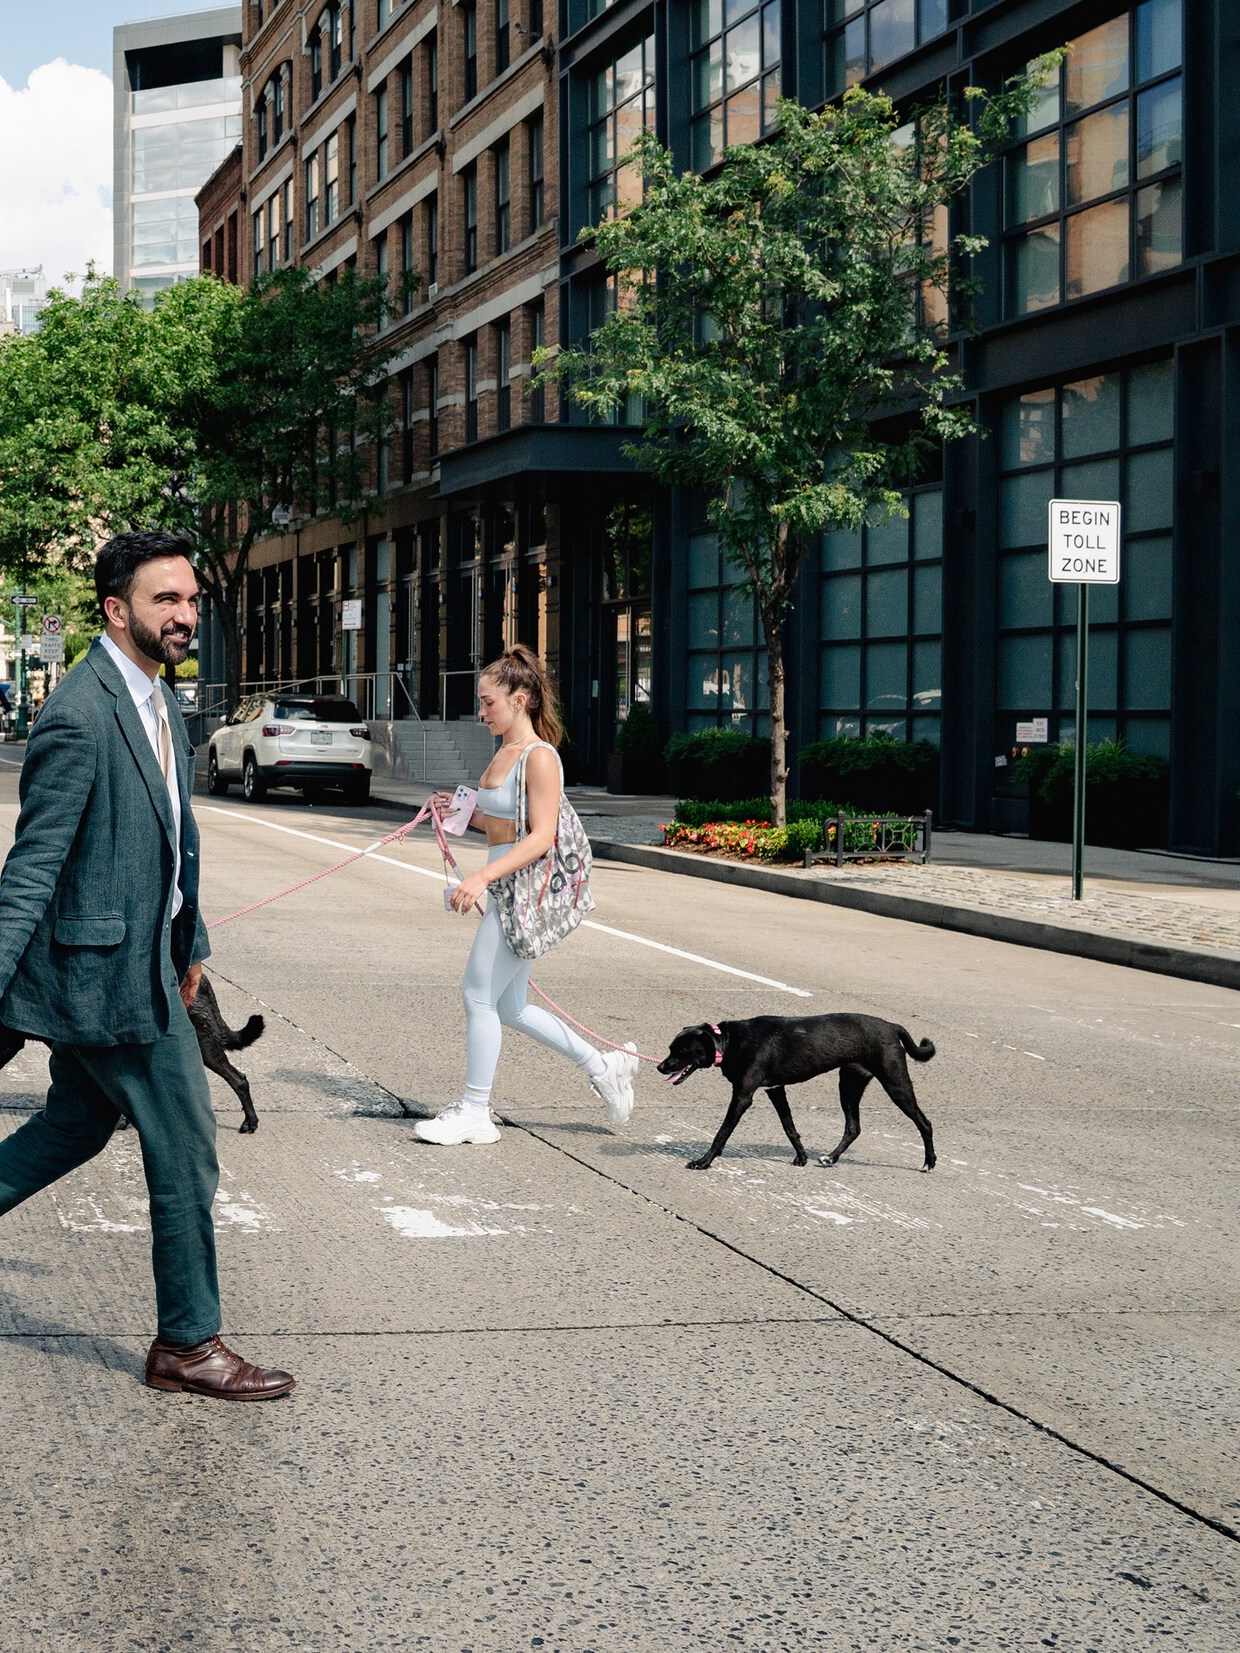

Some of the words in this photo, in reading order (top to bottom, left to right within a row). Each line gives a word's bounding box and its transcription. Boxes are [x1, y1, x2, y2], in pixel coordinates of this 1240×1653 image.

[1059, 510, 1110, 526] BEGIN
[1063, 534, 1106, 550] TOLL
[1061, 558, 1107, 573] ZONE
